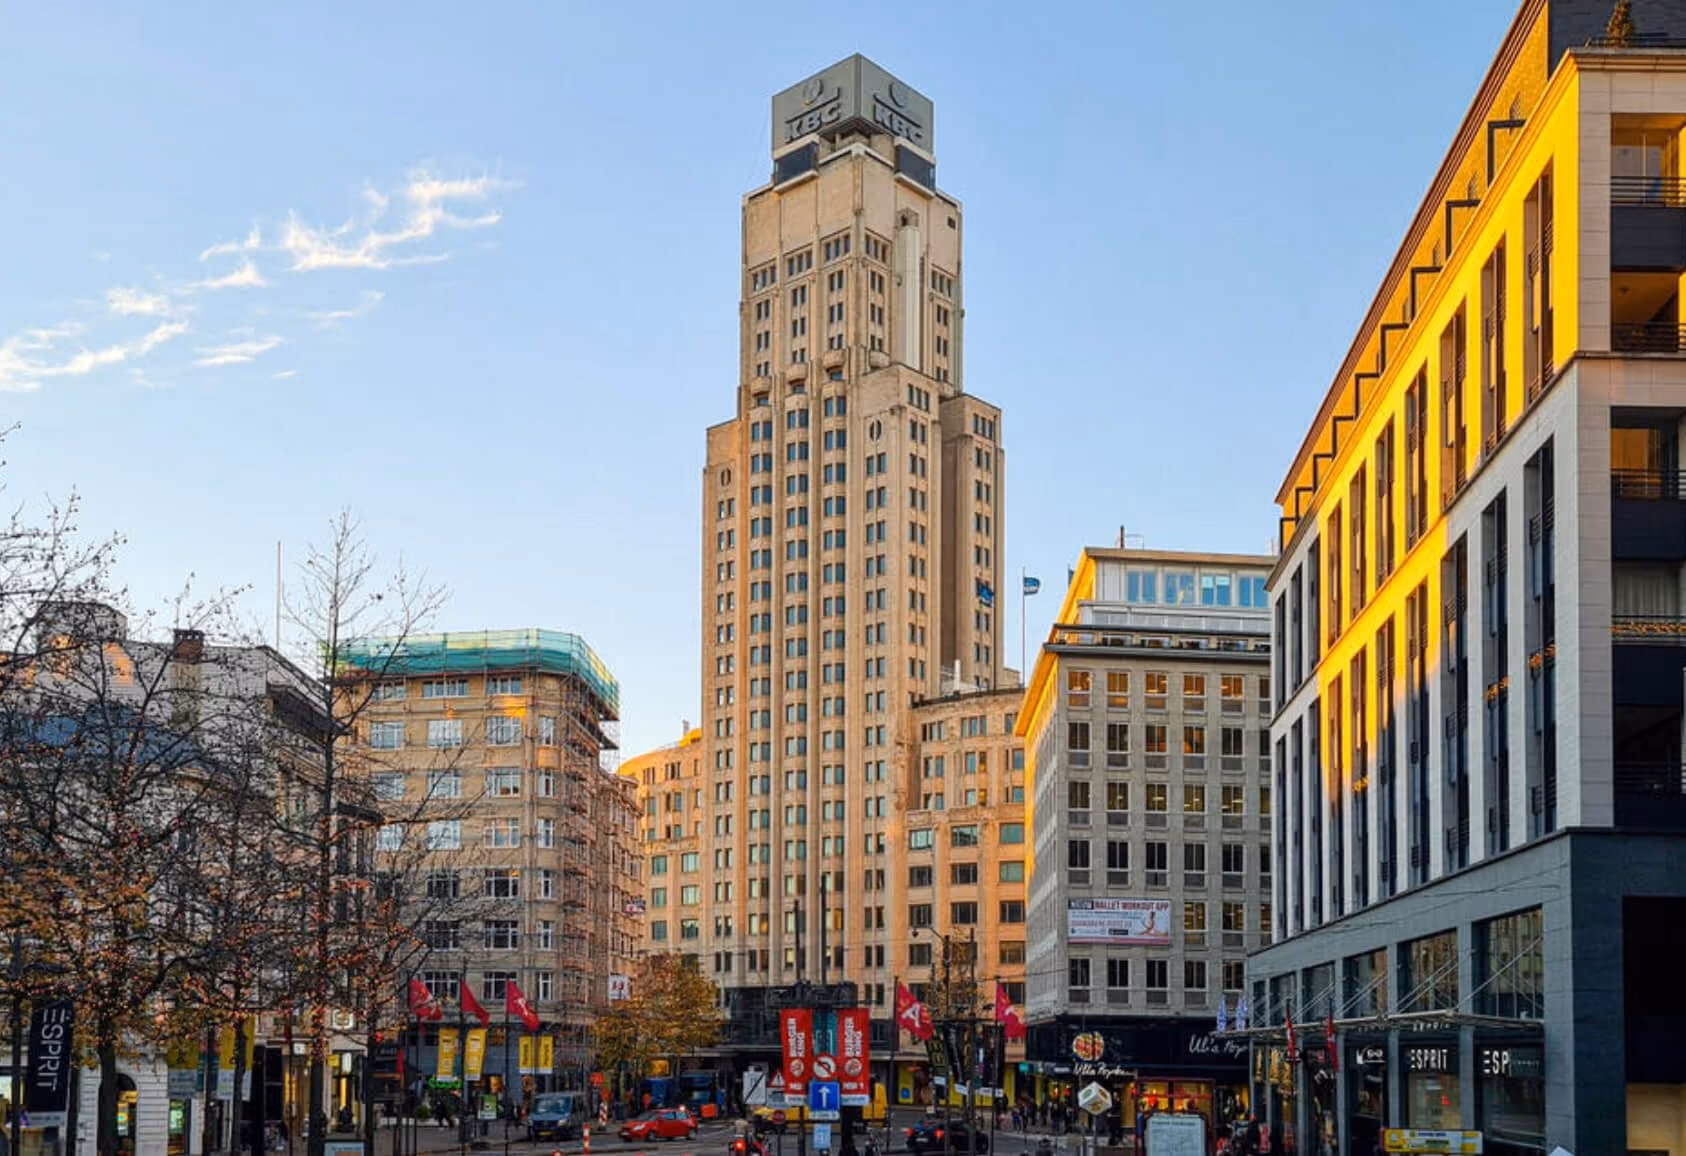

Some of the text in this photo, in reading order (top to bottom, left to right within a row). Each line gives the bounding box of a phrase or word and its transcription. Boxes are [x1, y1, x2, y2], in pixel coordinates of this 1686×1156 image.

[785, 102, 841, 144] KBC
[873, 103, 924, 144] KBC
[36, 1008, 66, 1091] ESPRIT
[1411, 1049, 1448, 1070] ESPRIT
